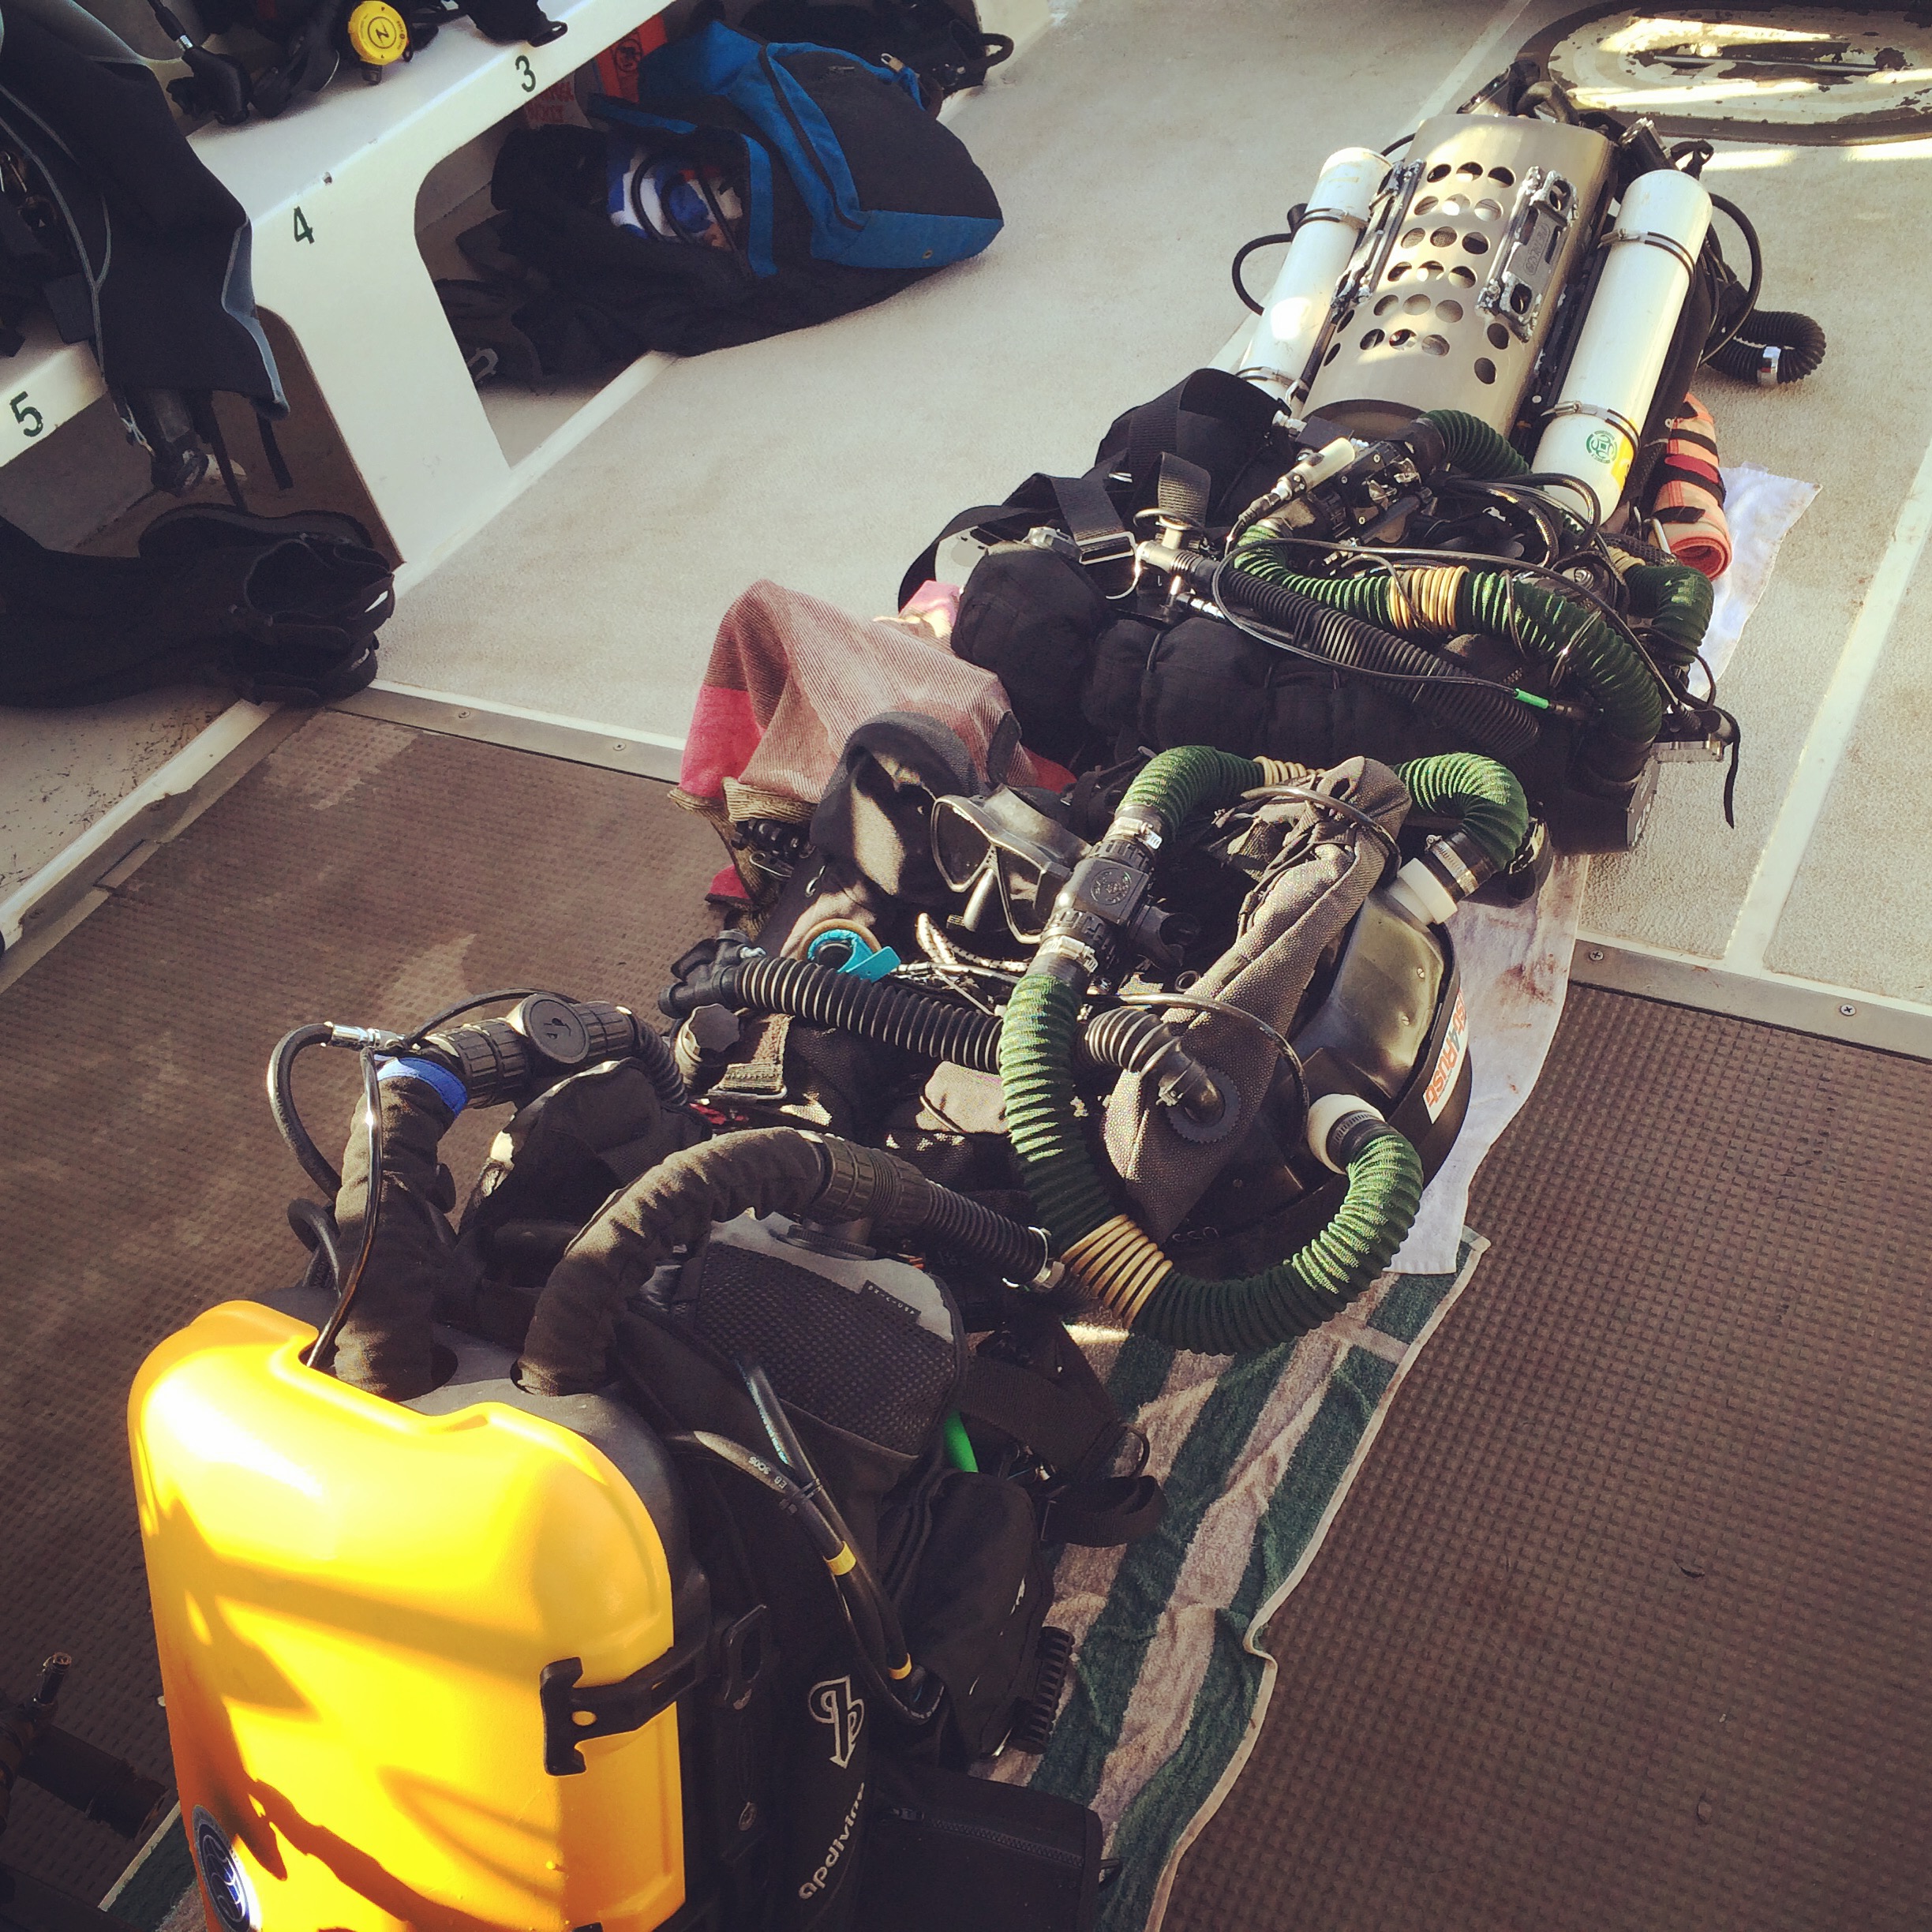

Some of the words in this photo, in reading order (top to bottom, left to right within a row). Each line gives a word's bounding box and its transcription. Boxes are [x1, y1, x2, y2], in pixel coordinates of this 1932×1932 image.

[515, 54, 536, 92] 3
[293, 206, 315, 244] 4
[9, 391, 43, 437] 5
